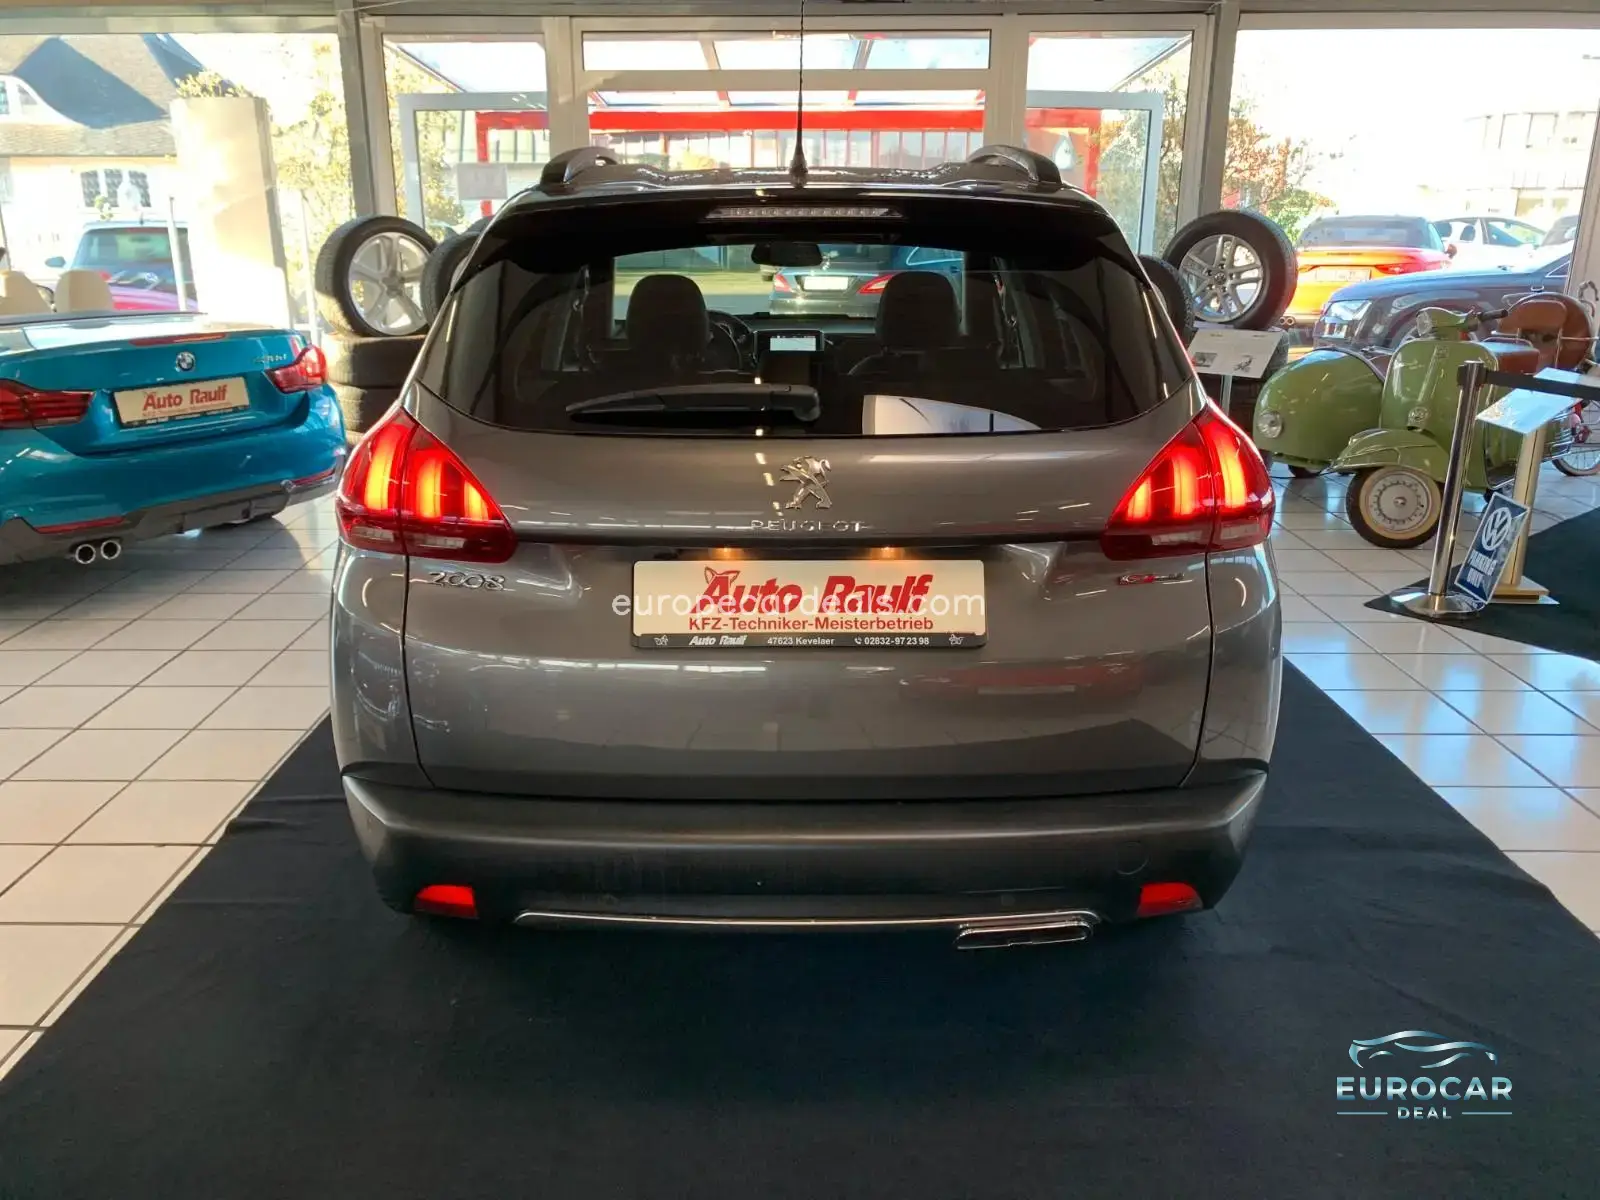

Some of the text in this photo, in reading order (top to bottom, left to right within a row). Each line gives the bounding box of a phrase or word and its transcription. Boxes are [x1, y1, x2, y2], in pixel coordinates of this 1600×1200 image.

[143, 392, 183, 411] Auto
[190, 384, 228, 404] Raulf
[750, 519, 865, 532] PEUGEOT
[690, 574, 934, 614] Auto Raulf
[689, 616, 934, 631] KFZ-Techniker-Meisterbetrieb
[689, 635, 717, 646] Auto
[767, 636, 835, 646] 47623 Kevelaer
